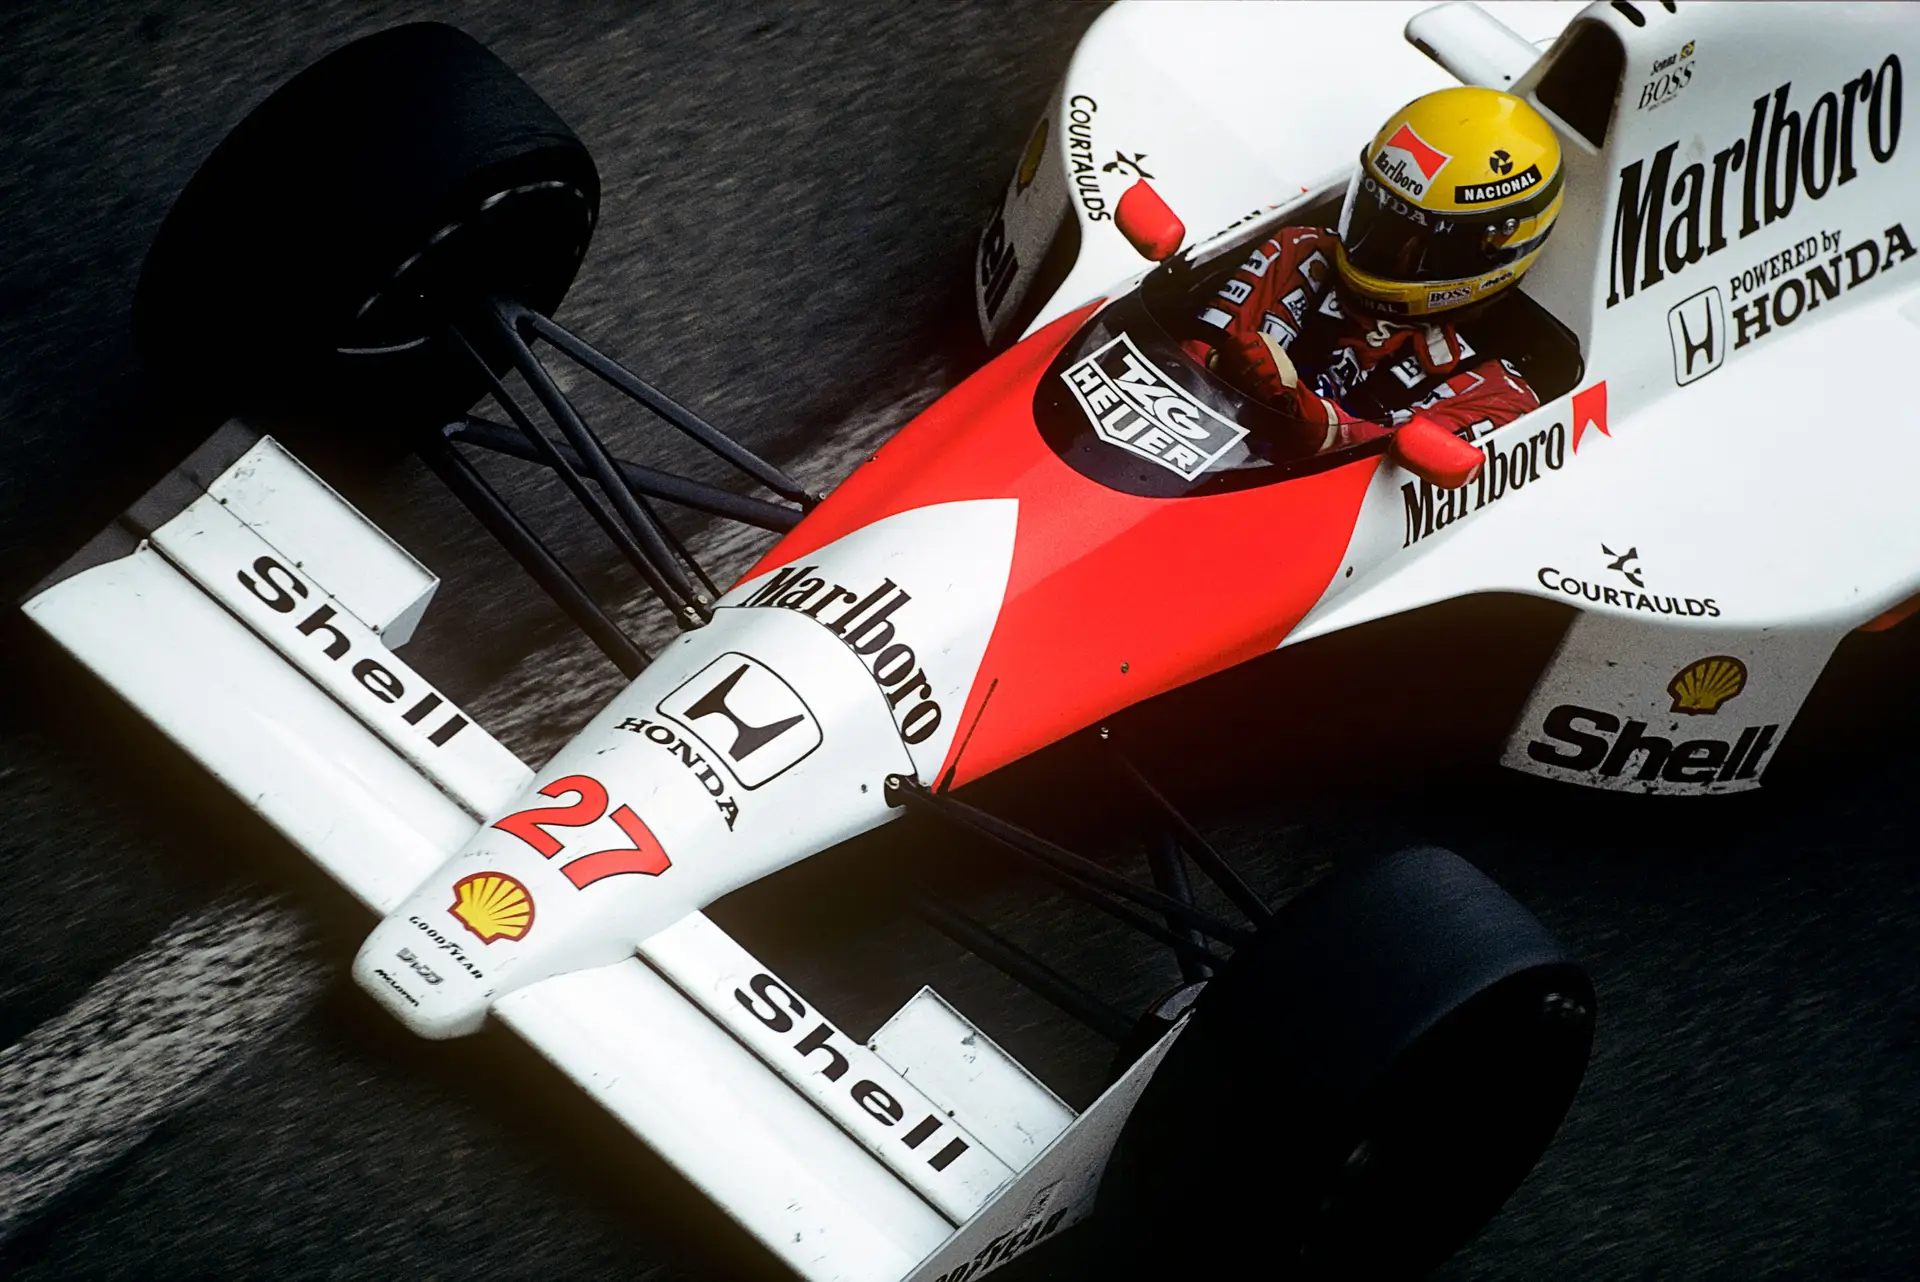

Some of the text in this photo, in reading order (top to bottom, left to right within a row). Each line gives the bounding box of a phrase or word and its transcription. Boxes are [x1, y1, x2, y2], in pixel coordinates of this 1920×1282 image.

[1638, 60, 1696, 110] BOSS
[1069, 94, 1111, 222] COURTAULDS
[1362, 176, 1427, 227] ONDA
[1374, 150, 1423, 196] Marlboro
[1464, 171, 1535, 200] NACIONAL
[1606, 53, 1904, 309] Marlboro
[1430, 287, 1471, 302] BOSS
[1729, 229, 1842, 300] POWERED by
[1734, 222, 1918, 350] HONDA
[1071, 365, 1200, 471] HEUER
[1112, 353, 1211, 440] TAG
[1537, 567, 1721, 618] COURTAULDS
[237, 555, 470, 748] Shell
[737, 565, 942, 745] Marlboro
[614, 716, 740, 832] HONDA
[1527, 704, 1780, 785] Shell
[491, 774, 673, 891] 27
[409, 915, 483, 979] GOODYEAR
[734, 973, 971, 1173] Shell
